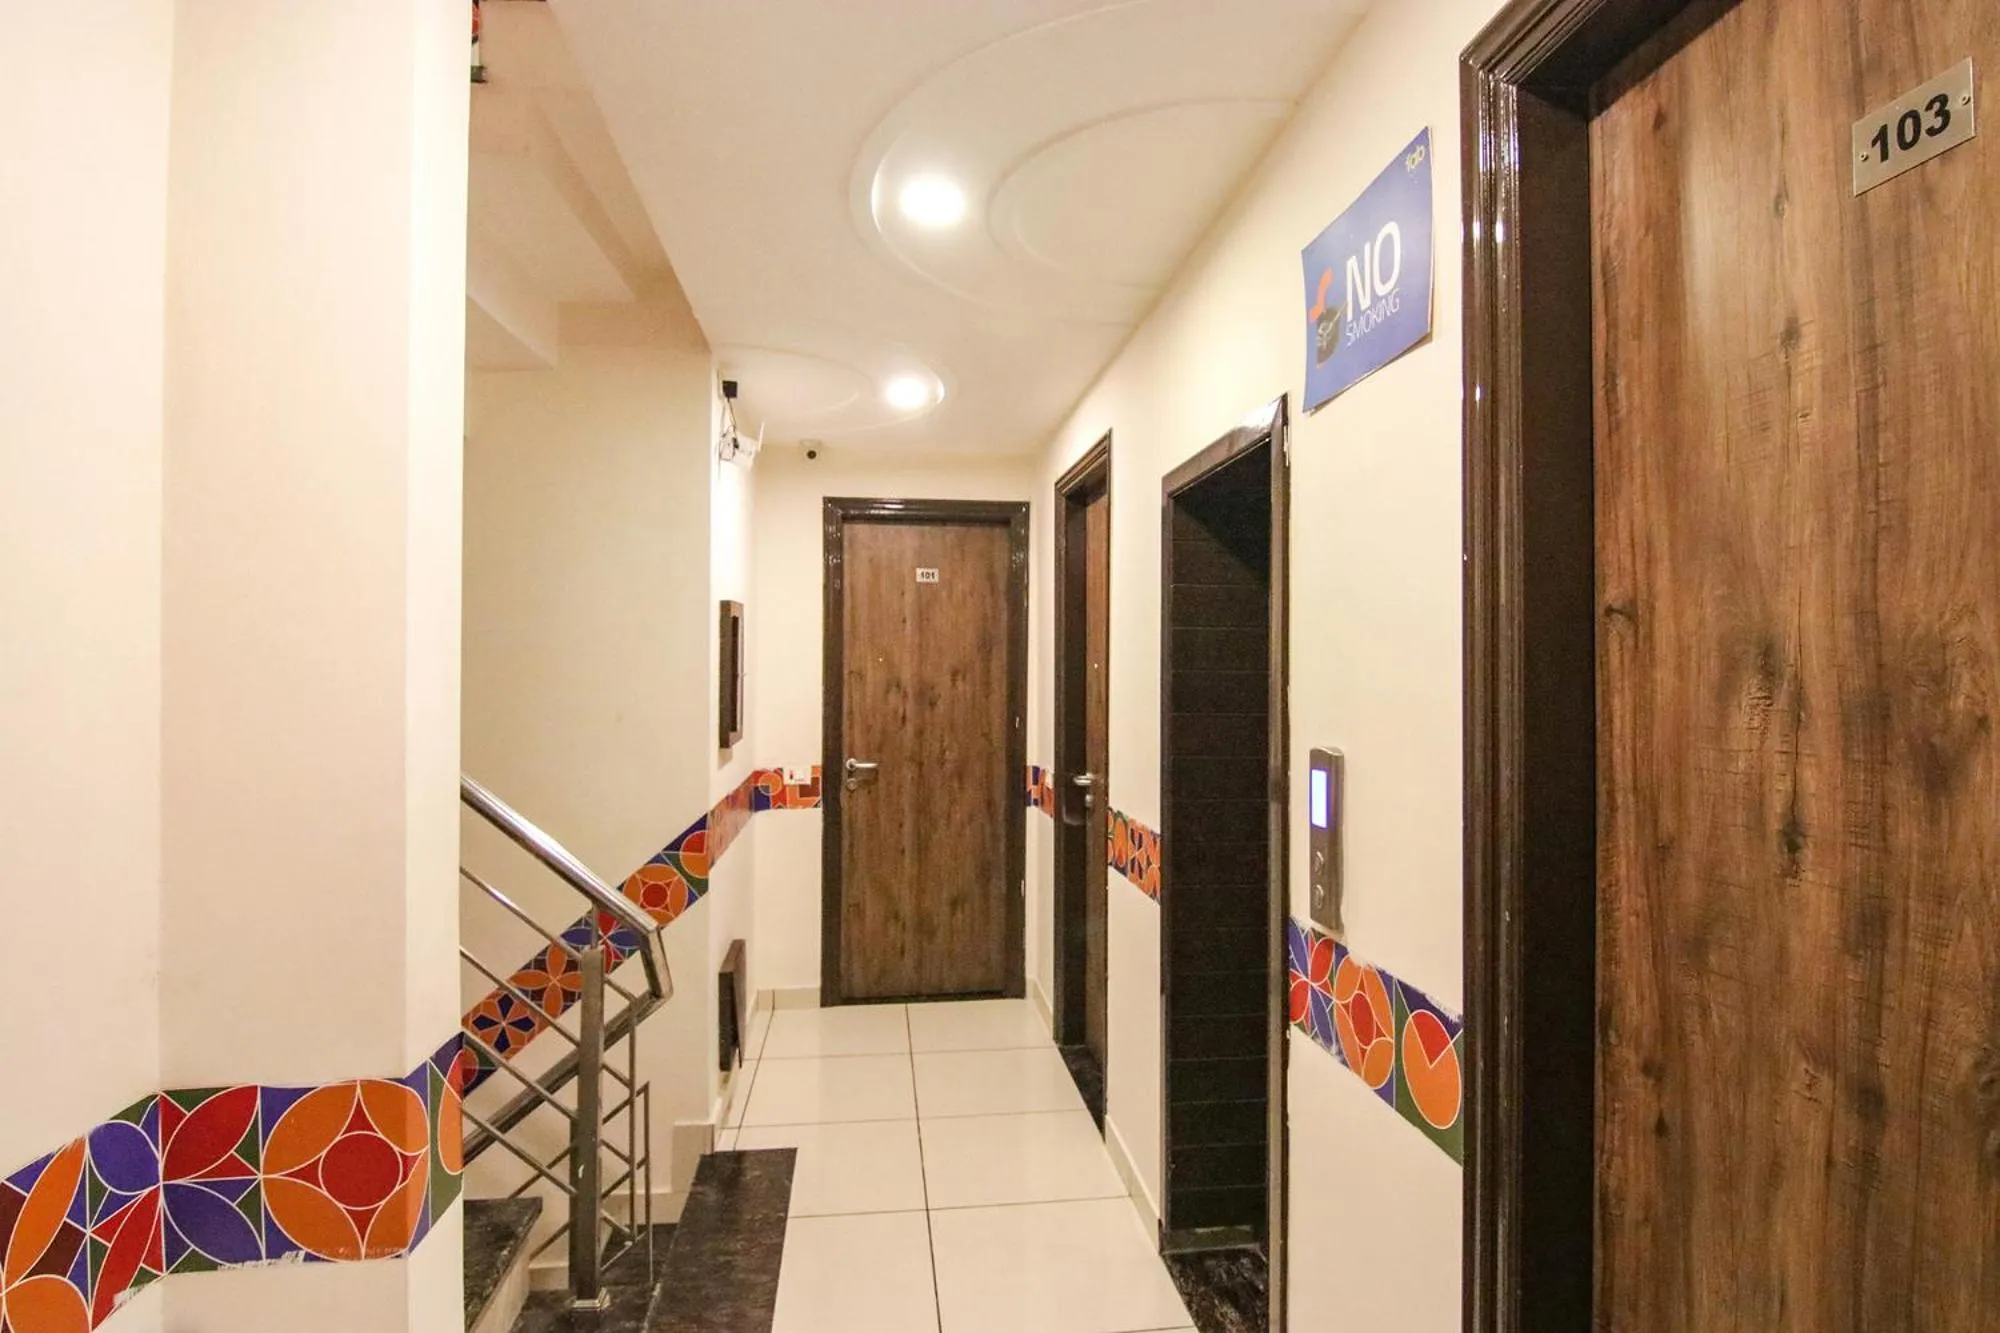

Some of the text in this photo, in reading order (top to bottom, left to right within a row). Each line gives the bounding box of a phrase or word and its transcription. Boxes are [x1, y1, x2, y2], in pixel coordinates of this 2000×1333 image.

[1871, 93, 1951, 163] 103
[1345, 221, 1401, 321] NO
[1346, 288, 1400, 346] SMOKING
[920, 571, 935, 580] 101
